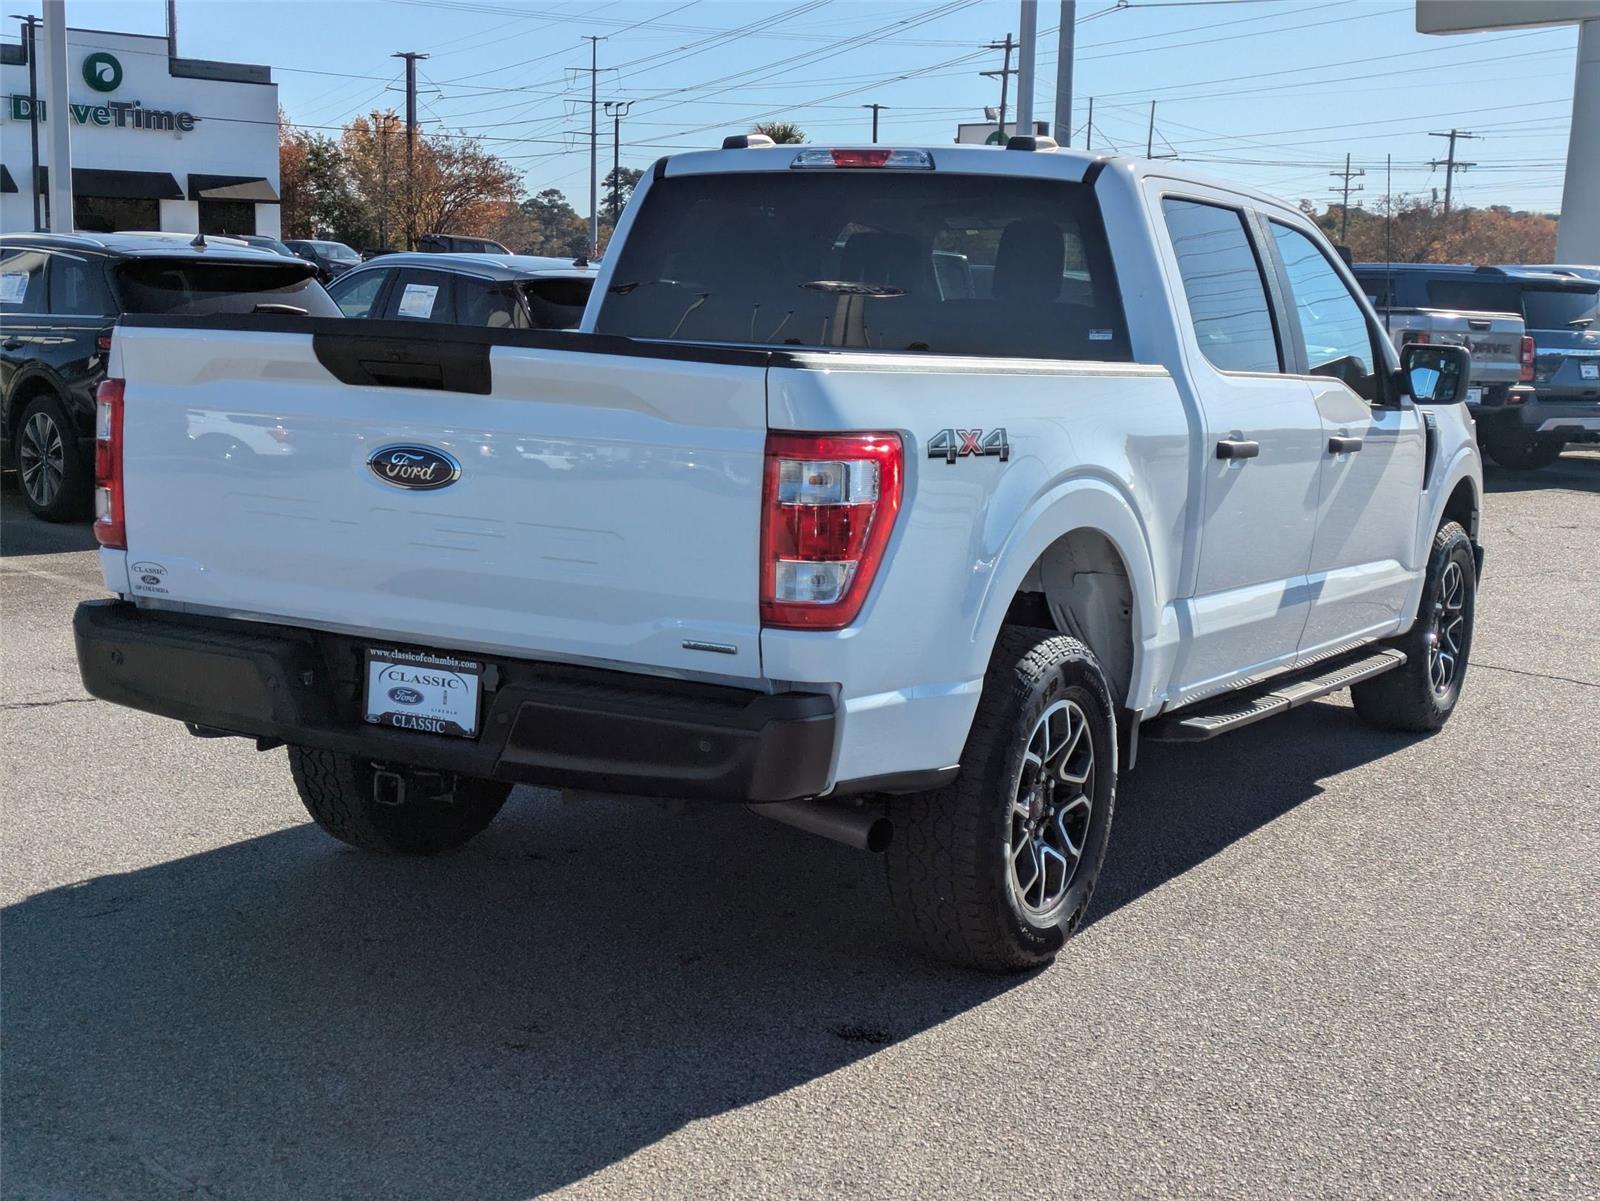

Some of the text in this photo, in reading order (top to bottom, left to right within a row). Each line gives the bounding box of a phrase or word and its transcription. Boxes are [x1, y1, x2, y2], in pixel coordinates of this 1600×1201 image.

[10, 94, 194, 131] DveTime
[386, 452, 439, 480] Ford
[134, 566, 165, 575] CLASSIC
[369, 648, 477, 669] www.classicofcolumbia.com
[388, 670, 459, 690] CLASSIC
[394, 689, 417, 703] Ford
[392, 714, 446, 734] CLASSIC
